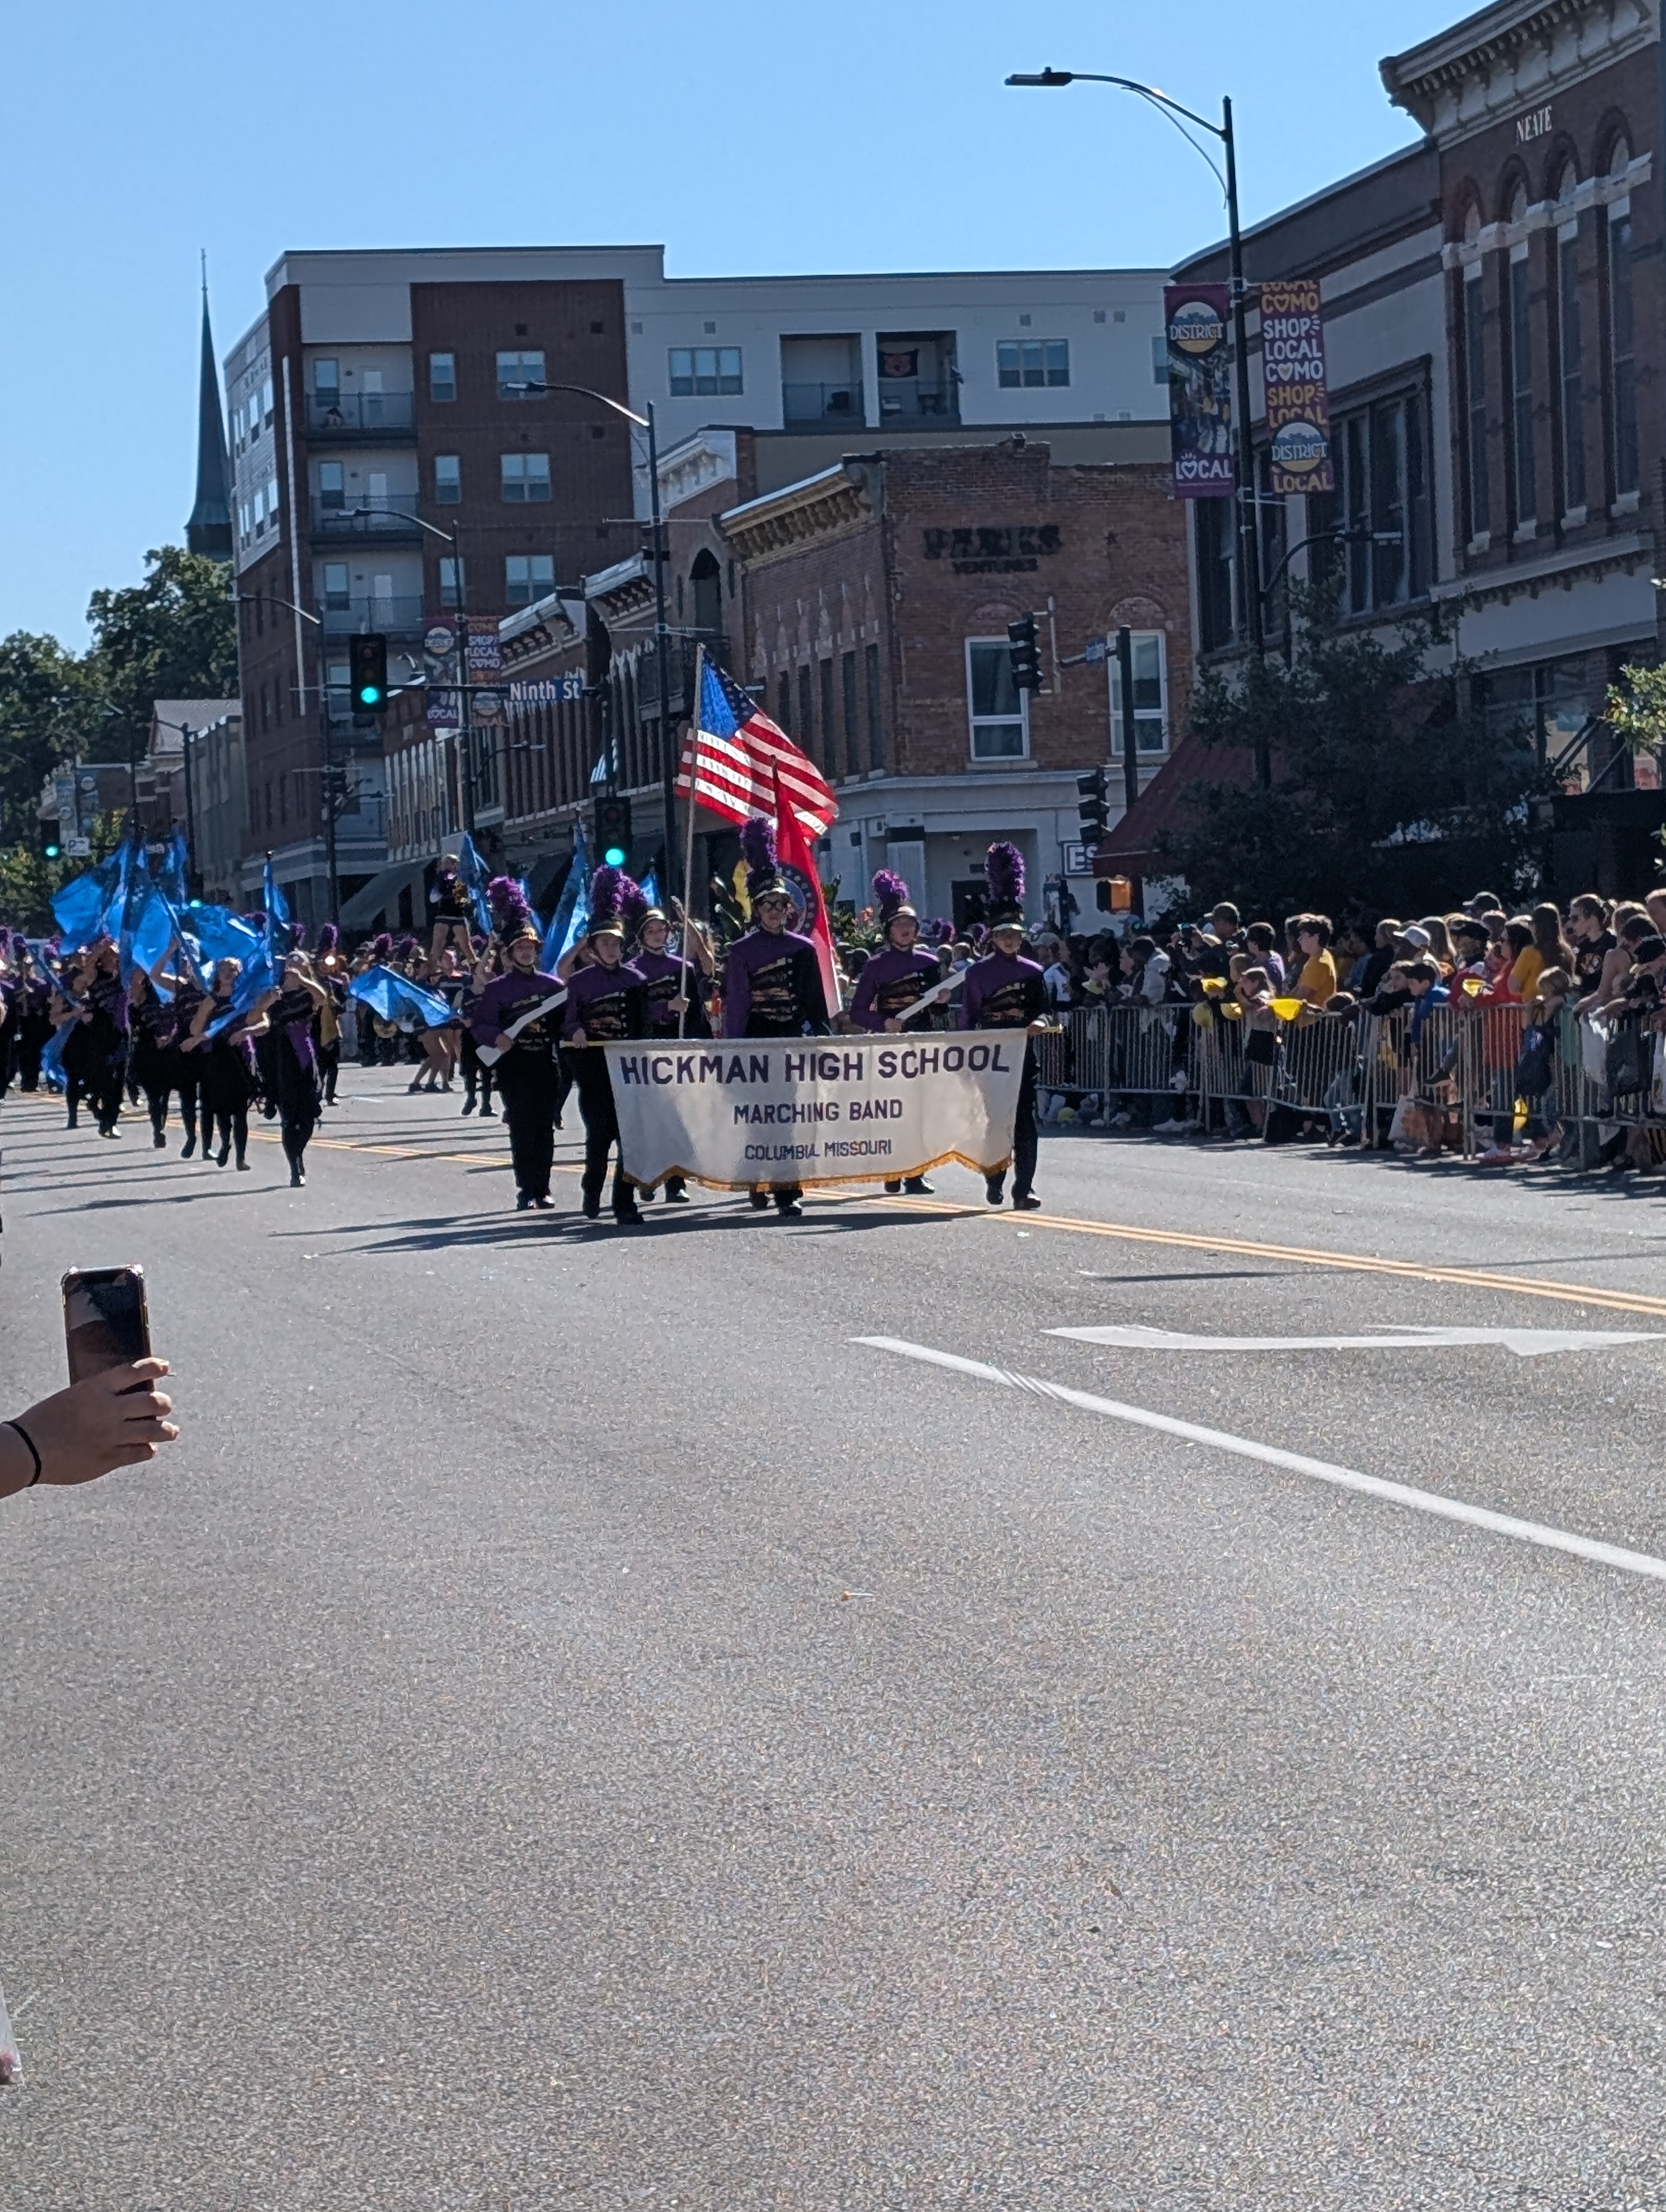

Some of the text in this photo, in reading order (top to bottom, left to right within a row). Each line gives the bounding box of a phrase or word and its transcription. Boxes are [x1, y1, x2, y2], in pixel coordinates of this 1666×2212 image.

[1516, 105, 1552, 146] NEATE
[1261, 292, 1318, 314] COMO
[1169, 323, 1223, 340] DISTRICT
[1263, 318, 1310, 339] SHOP
[1264, 339, 1322, 361] LOCAL
[1265, 361, 1323, 383] COMO
[1267, 384, 1315, 407] SHOP
[1271, 442, 1327, 461] DISTRICT
[1175, 459, 1233, 480] LOCAL
[1273, 471, 1332, 493] LOCAL
[469, 635, 494, 646] SHOP
[470, 647, 499, 657] LOCAL
[510, 681, 580, 700] Ninth St
[620, 1044, 1010, 1085] HICKMAN HIGH SCHOOL
[734, 1098, 902, 1124] MARCHING BAND
[824, 1139, 892, 1158] MISSOURI
